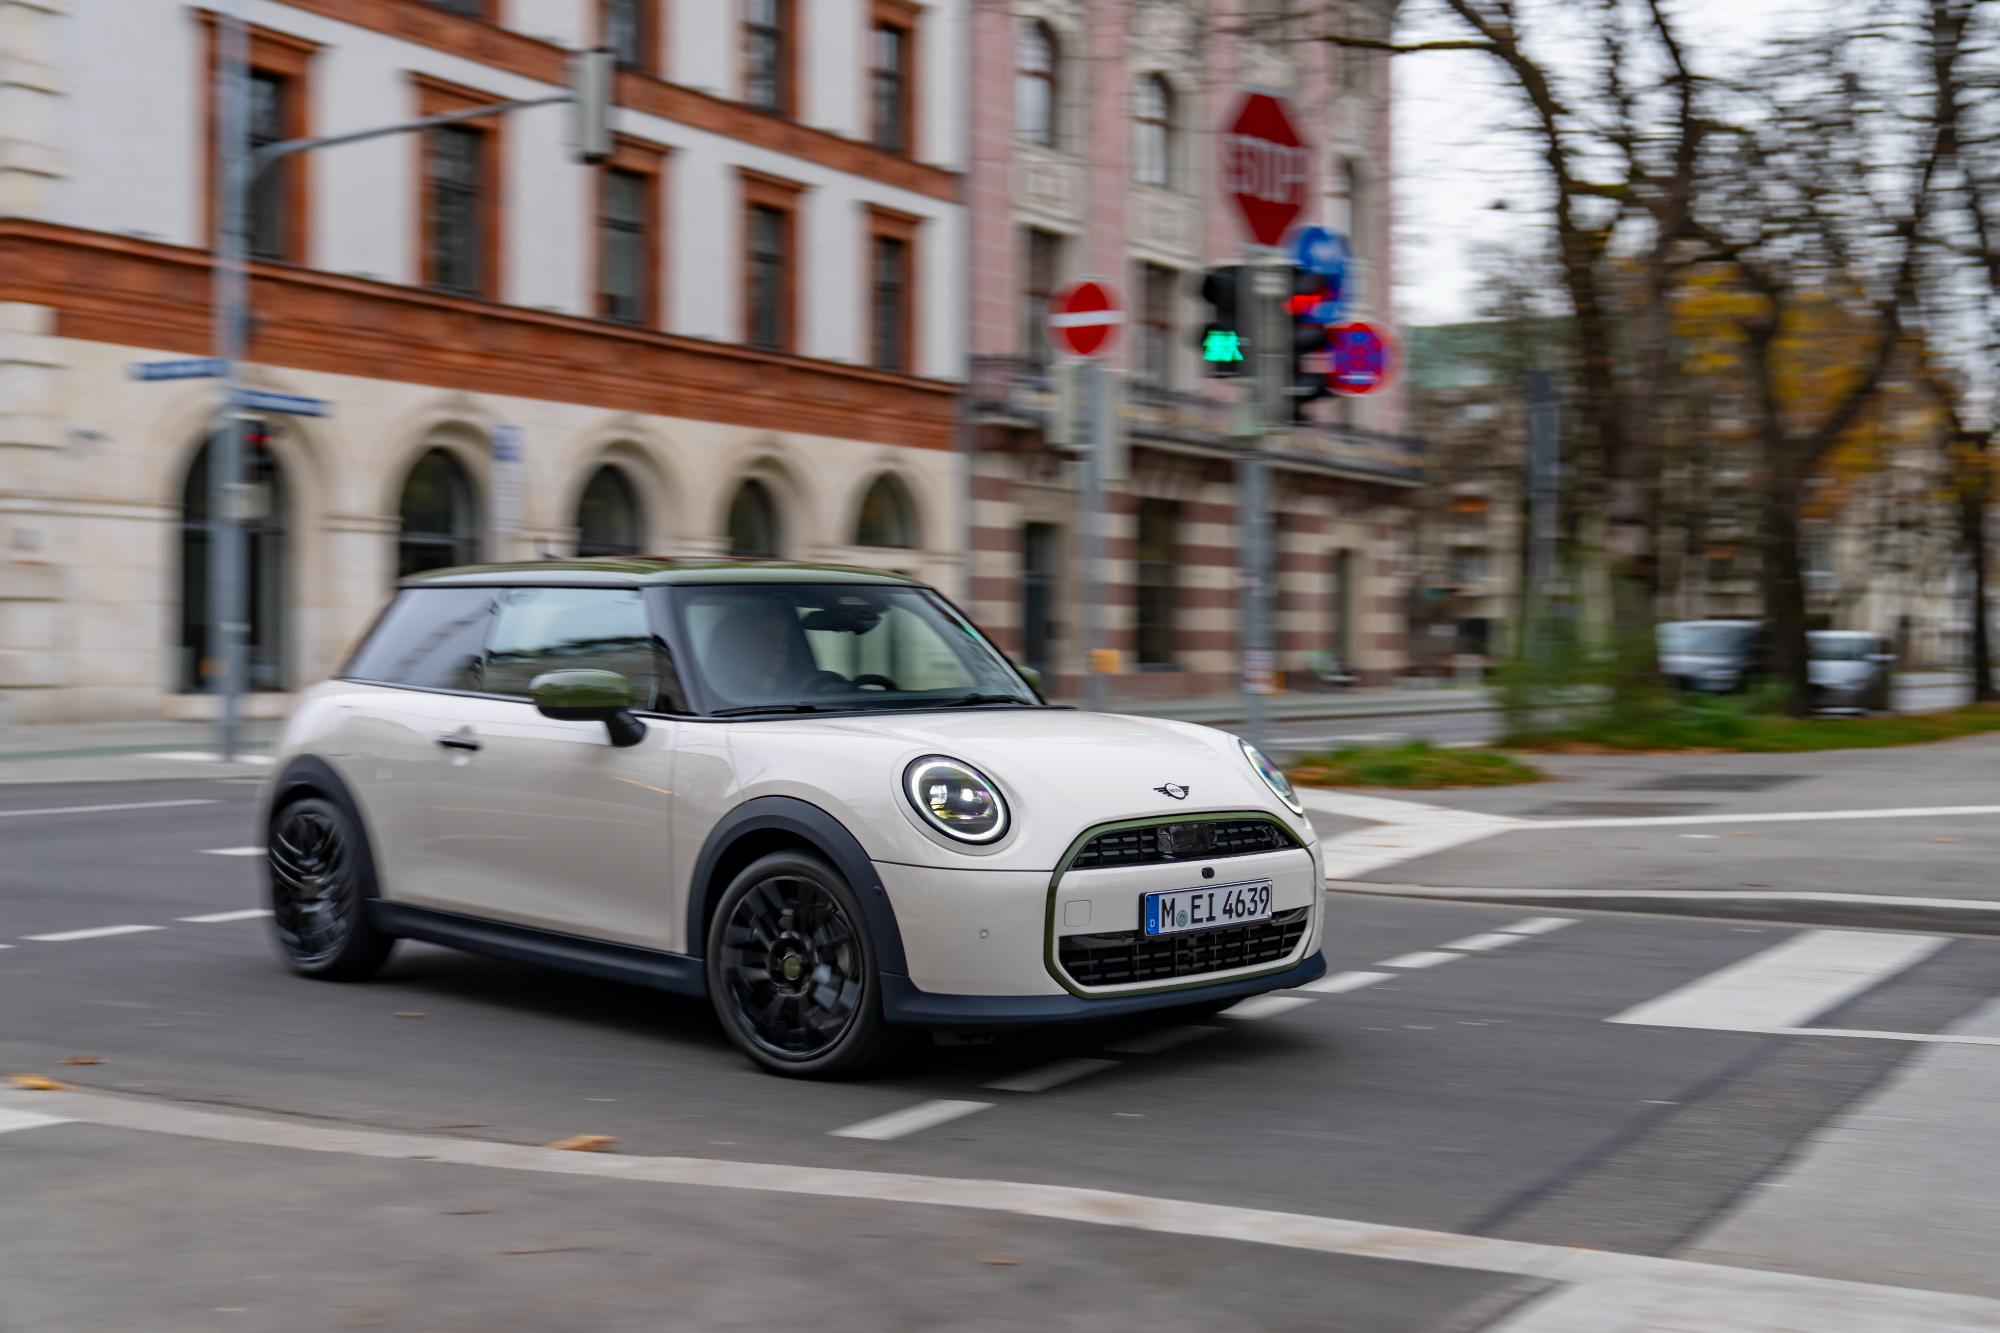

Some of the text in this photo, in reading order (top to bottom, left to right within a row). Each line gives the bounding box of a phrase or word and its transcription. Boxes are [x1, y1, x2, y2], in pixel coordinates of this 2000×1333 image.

[1223, 132, 1310, 202] STOP
[1150, 918, 1156, 928] D
[1161, 886, 1270, 928] M EI 4639
